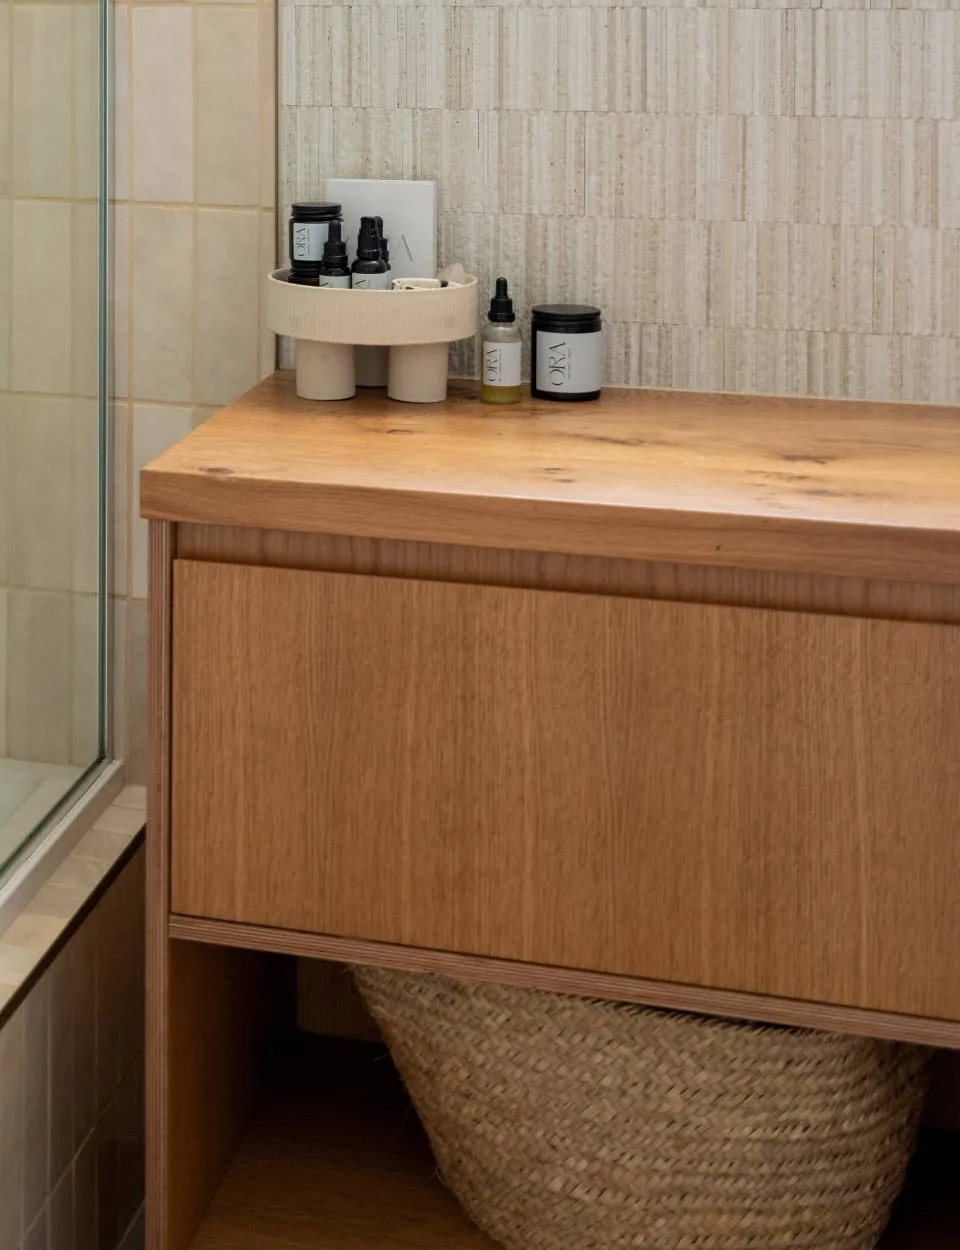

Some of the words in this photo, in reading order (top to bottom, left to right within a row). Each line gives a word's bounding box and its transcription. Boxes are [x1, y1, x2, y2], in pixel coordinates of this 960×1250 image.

[296, 228, 306, 257] ORA
[486, 349, 498, 382] ORA
[549, 342, 566, 386] ORA
